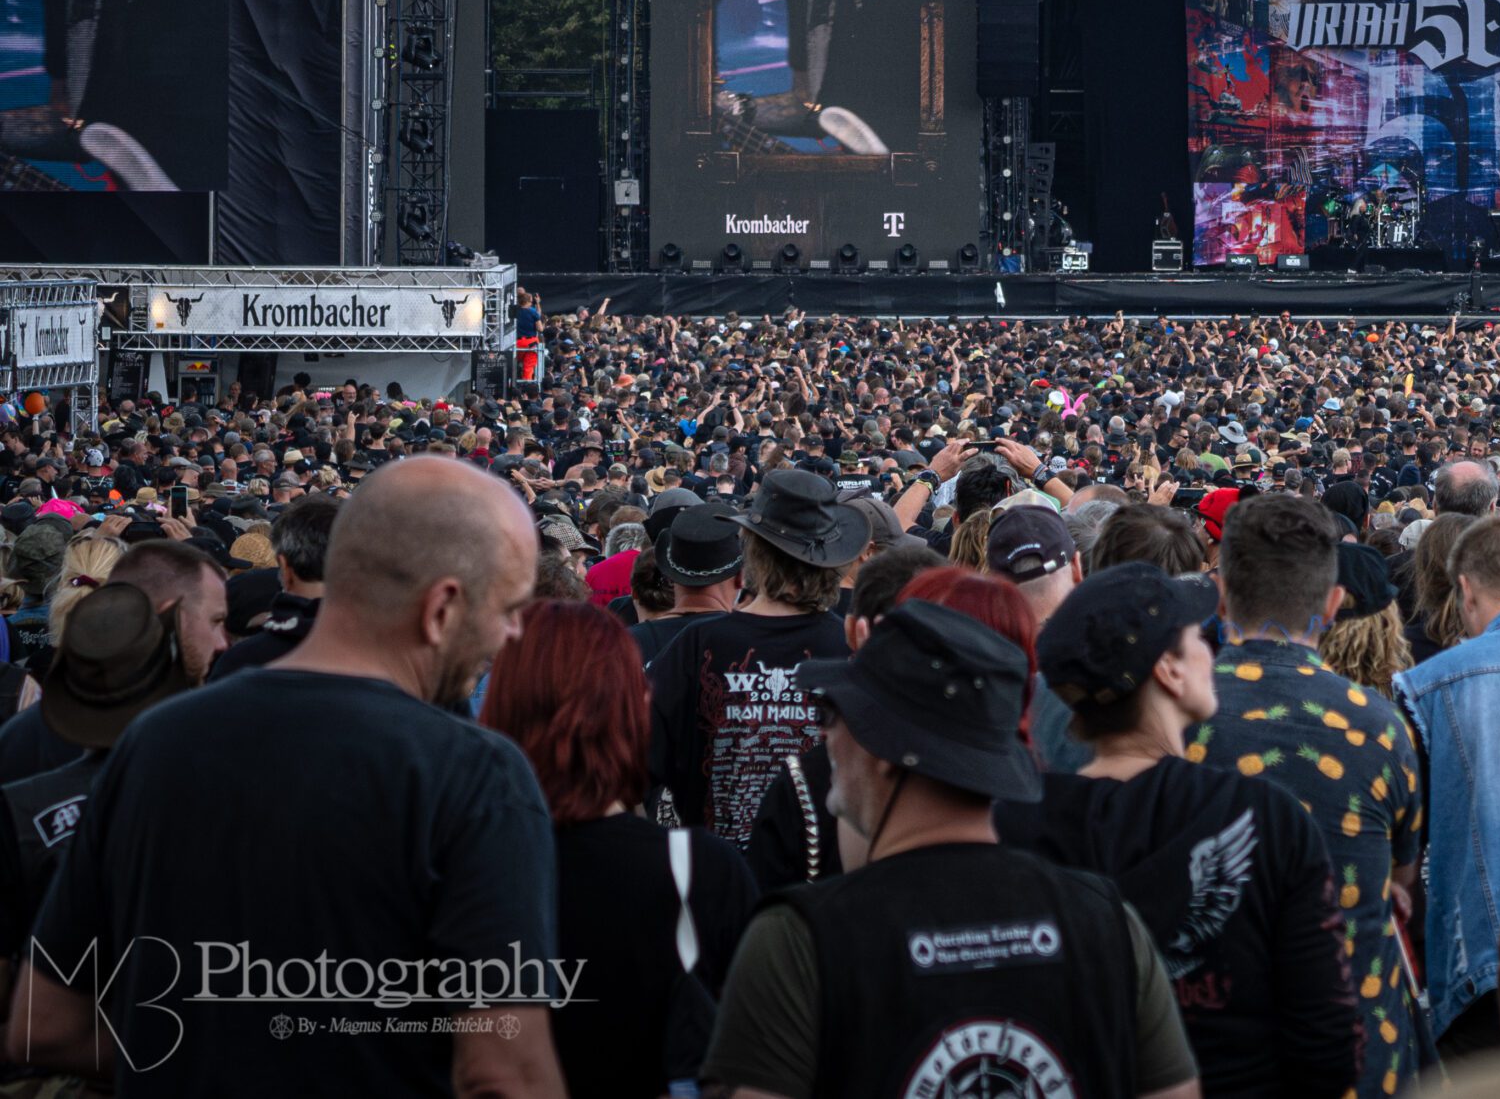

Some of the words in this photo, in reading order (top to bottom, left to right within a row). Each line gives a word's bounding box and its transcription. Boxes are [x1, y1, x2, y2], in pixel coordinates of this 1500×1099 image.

[1287, 2, 1409, 51] URIAH
[725, 214, 809, 234] Krombacher
[242, 293, 391, 327] Krombacher
[726, 705, 764, 722] IRON
[767, 705, 817, 723] MAIDE
